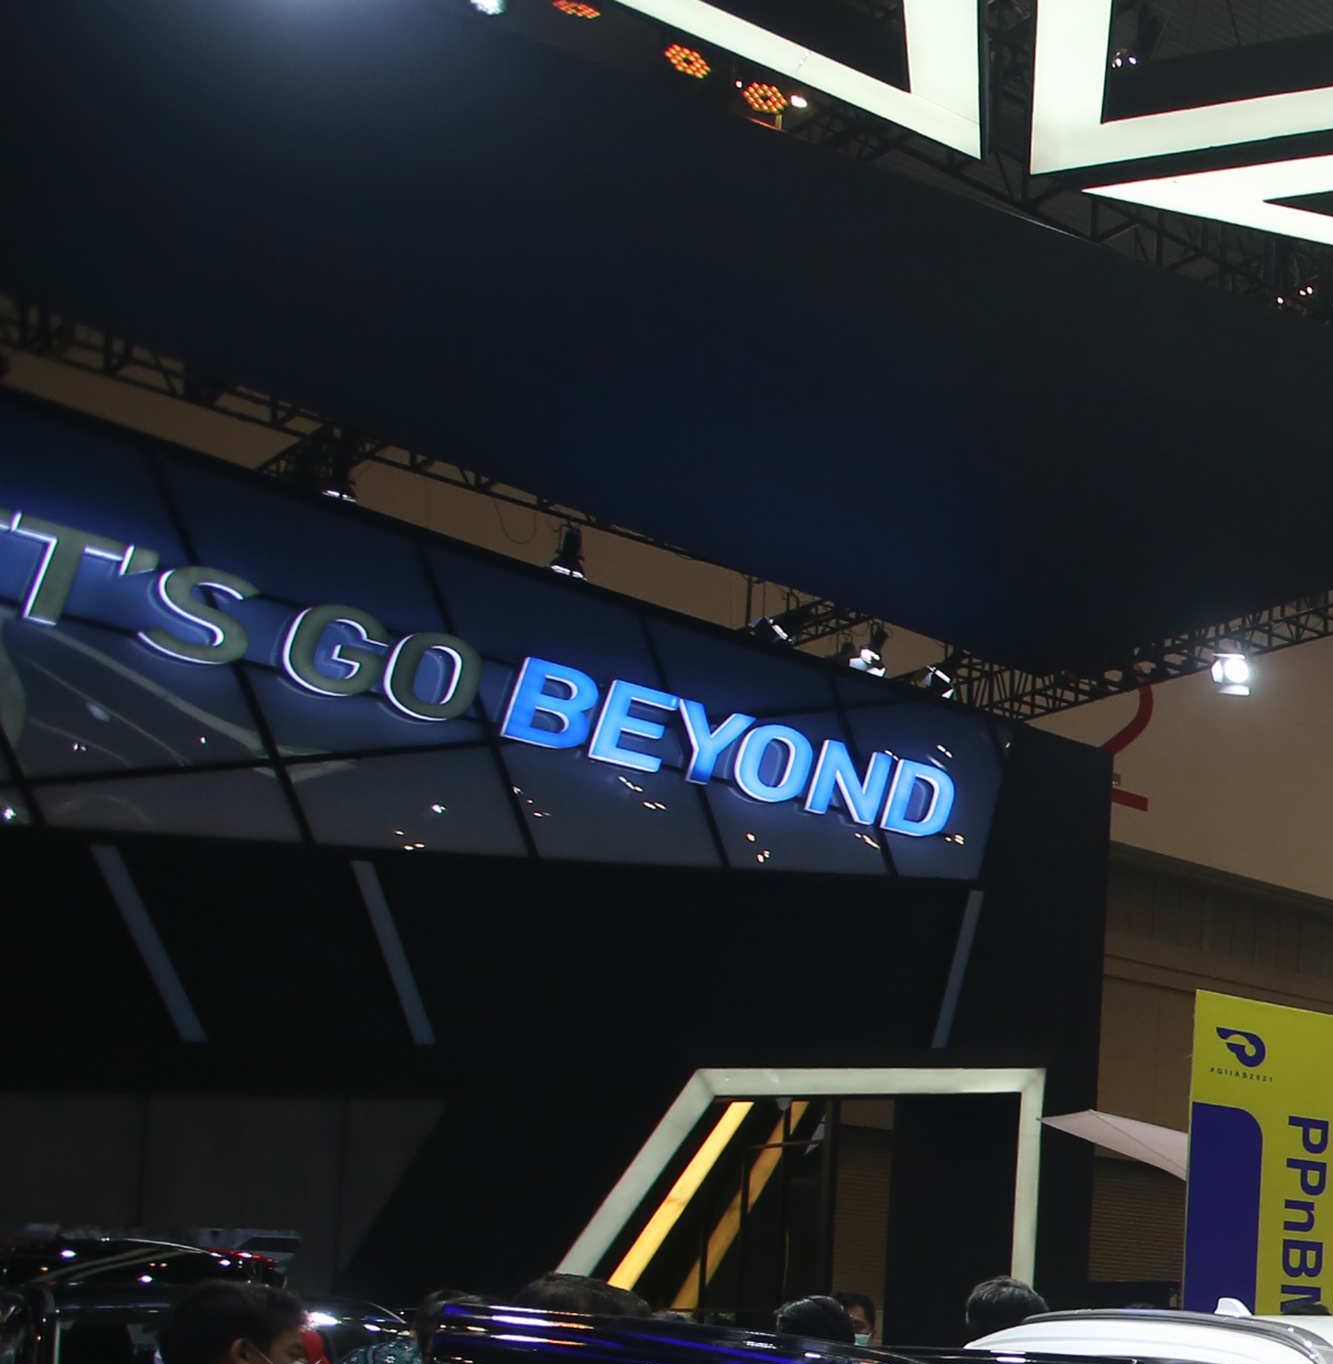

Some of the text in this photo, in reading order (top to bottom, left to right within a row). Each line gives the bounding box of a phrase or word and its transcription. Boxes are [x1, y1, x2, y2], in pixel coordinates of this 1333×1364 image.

[0, 510, 956, 839] T'S GO BEYOND
[1210, 1067, 1273, 1082] #GIIAS2021
